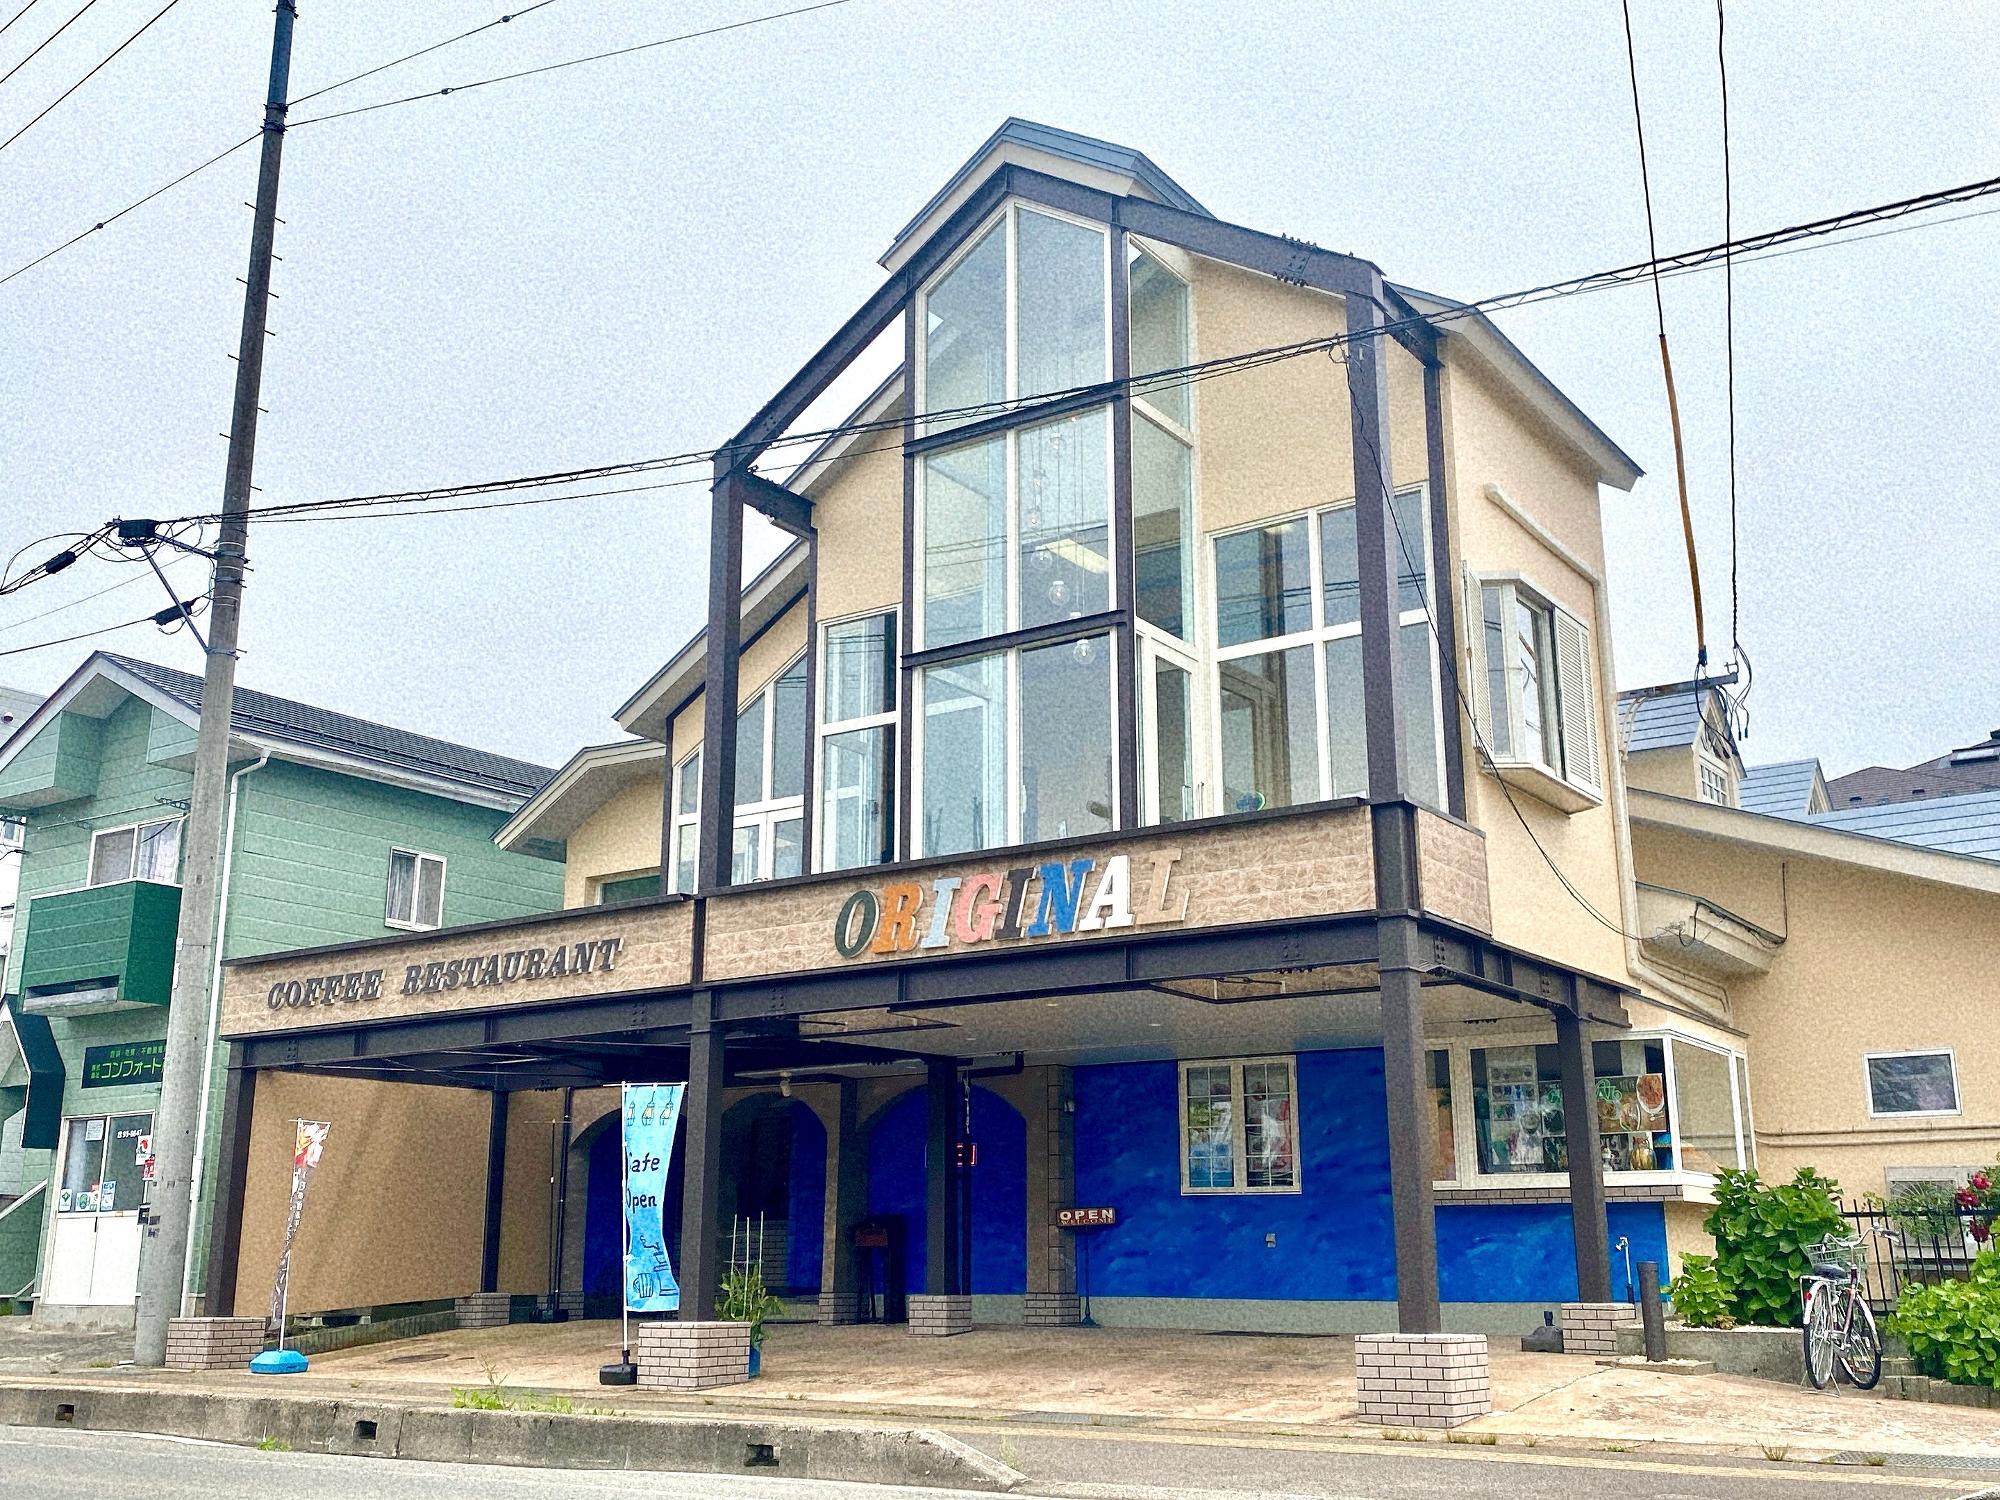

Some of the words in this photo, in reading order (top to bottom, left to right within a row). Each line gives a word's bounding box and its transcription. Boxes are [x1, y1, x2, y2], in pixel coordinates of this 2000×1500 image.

[834, 848, 1191, 958] ORIGINAL
[268, 970, 384, 1009] COFFEE
[401, 938, 622, 995] RESTAURANT
[101, 1057, 164, 1079] コンフォート
[629, 1152, 660, 1172] afe
[1060, 1209, 1113, 1220] OPEN
